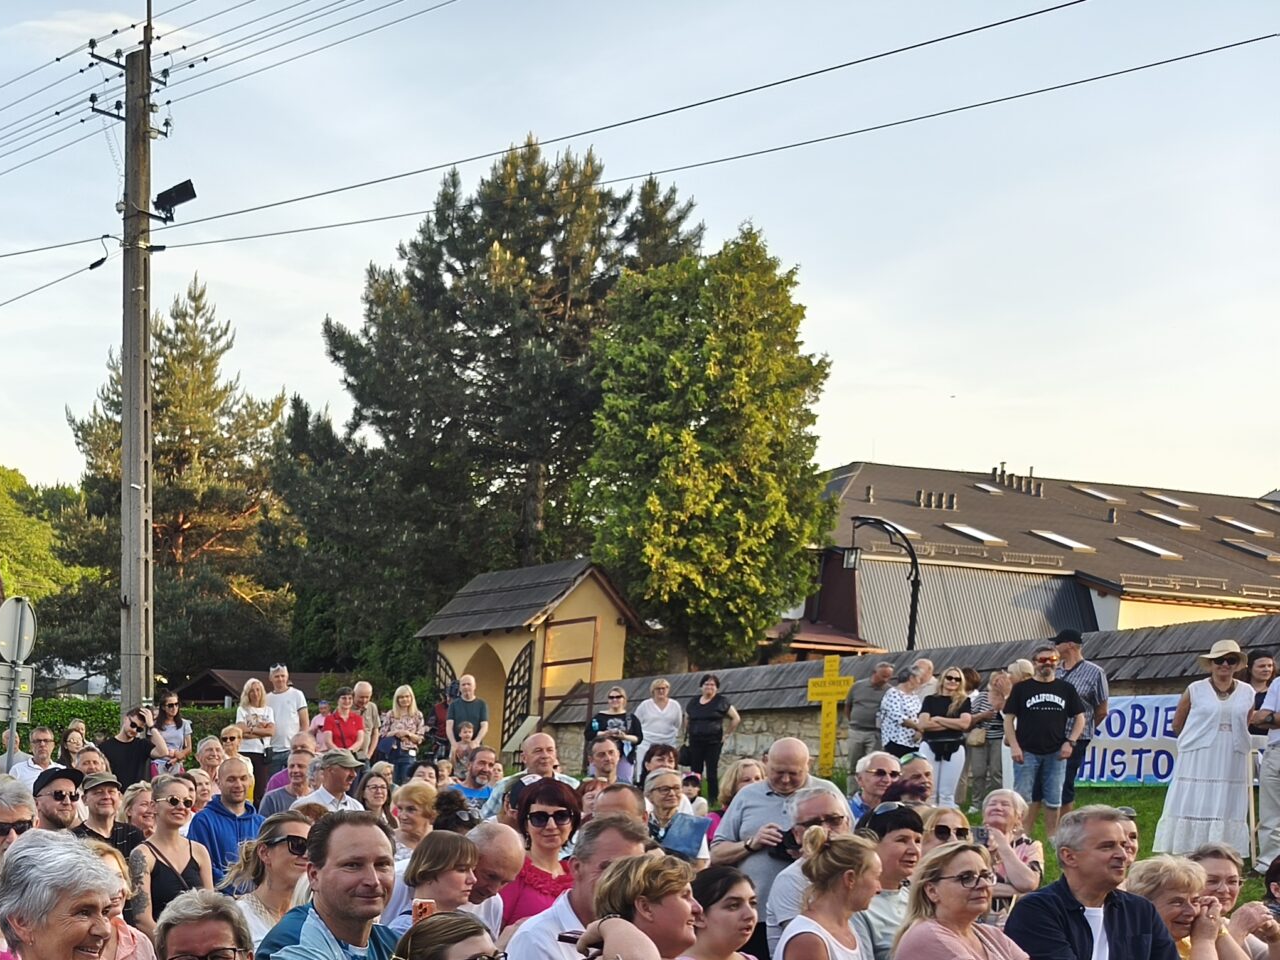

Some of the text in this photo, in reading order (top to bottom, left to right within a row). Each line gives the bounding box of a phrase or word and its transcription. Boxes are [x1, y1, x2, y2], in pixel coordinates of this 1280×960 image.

[1026, 693, 1066, 709] CALIFORNIA
[1094, 703, 1179, 739] OBIE
[1078, 746, 1174, 780] HISTO
